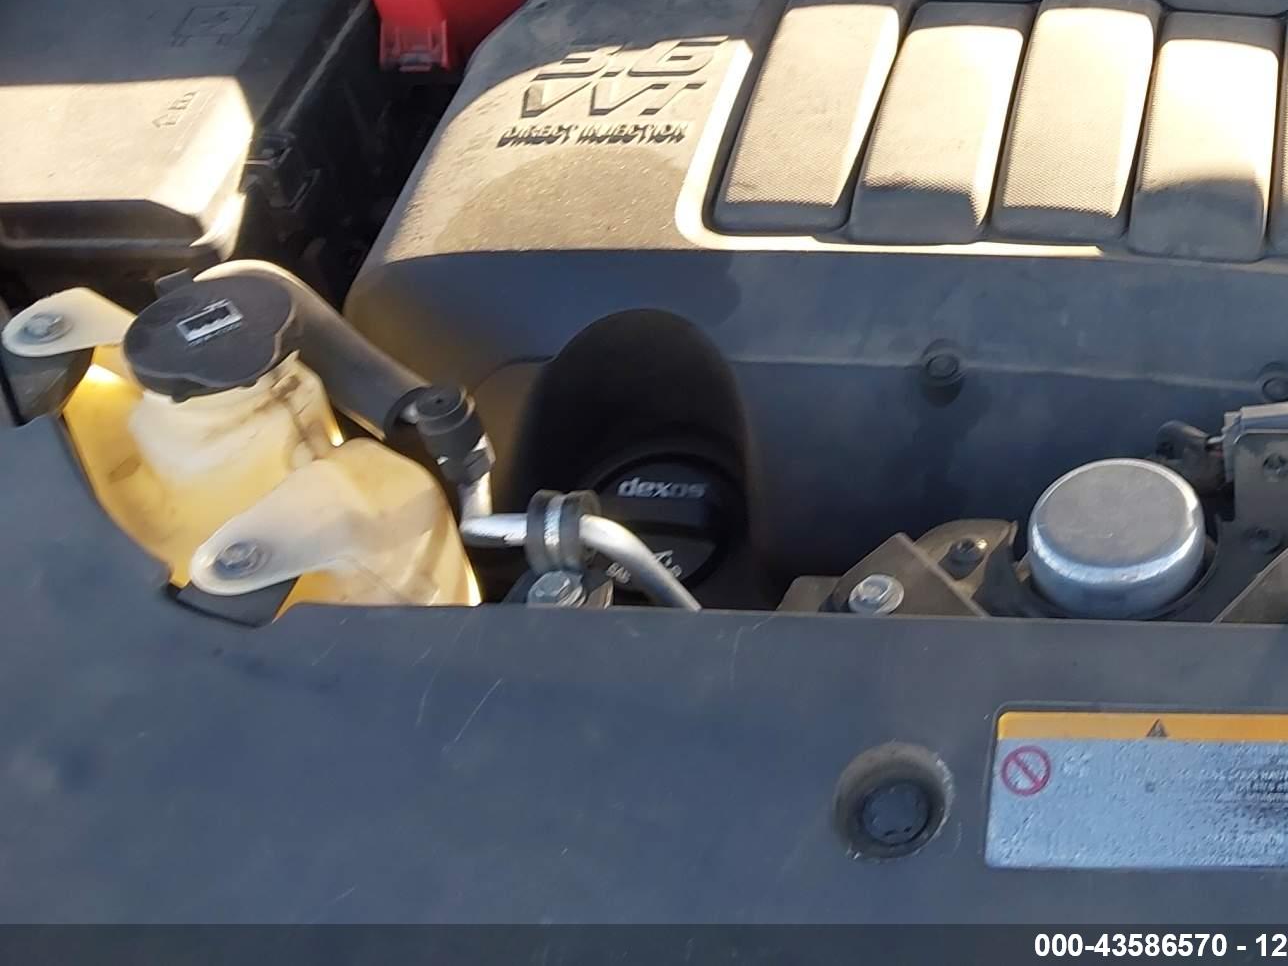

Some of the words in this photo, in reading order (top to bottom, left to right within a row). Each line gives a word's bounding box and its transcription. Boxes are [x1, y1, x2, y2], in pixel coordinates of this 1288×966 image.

[531, 35, 729, 82] 3.6
[520, 81, 706, 119] VVT
[497, 124, 576, 148] DIRECT
[577, 124, 688, 144] INJECTION
[616, 476, 706, 499] dexos
